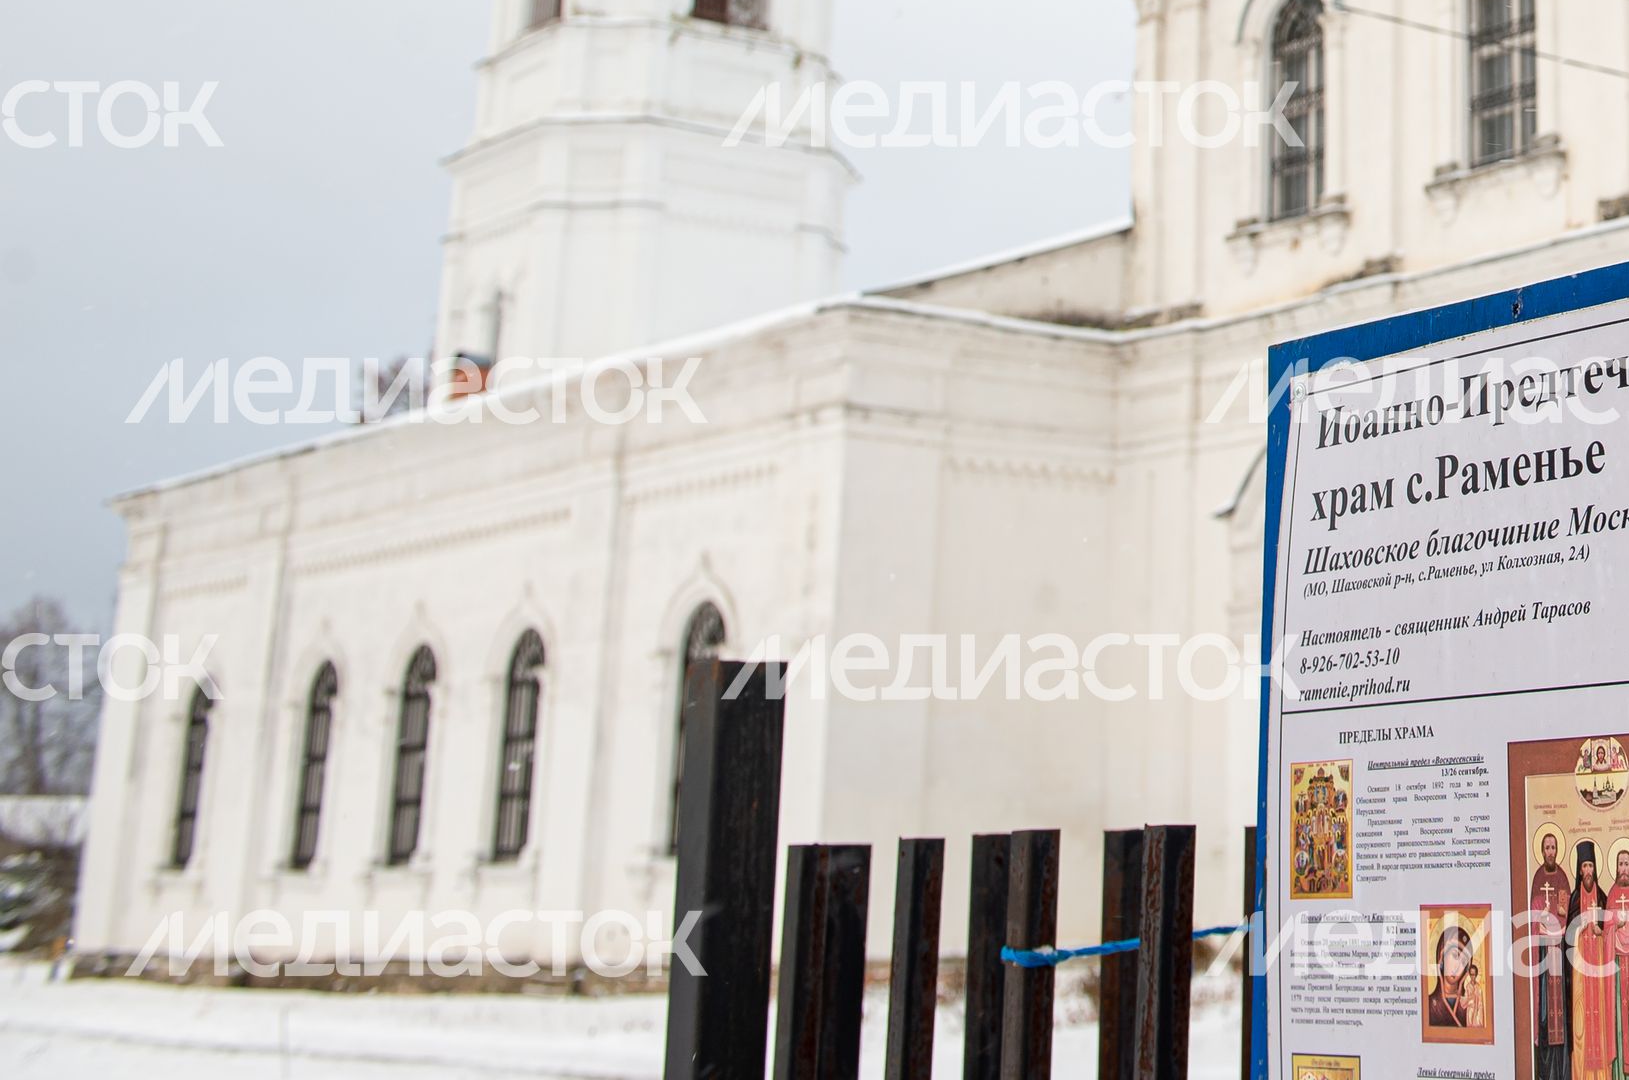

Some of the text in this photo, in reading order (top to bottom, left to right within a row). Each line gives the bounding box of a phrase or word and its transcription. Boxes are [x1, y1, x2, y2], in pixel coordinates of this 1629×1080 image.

[1312, 441, 1605, 530] храм с.Раменье
[1303, 540, 1420, 574] Шаховское
[1426, 519, 1560, 556] благочиние
[1303, 544, 1590, 599] (МО, Шаховской р-н, с.Раменье, ул Колхозная, 2А)
[1300, 626, 1382, 647] Настоятель
[1394, 615, 1470, 636] священник
[1472, 604, 1526, 629] Андрей
[1531, 601, 1591, 623] Тарасов
[1299, 647, 1400, 674] 8-926-702-53-10
[1298, 676, 1410, 701] ramenie.prihod.ru
[1339, 725, 1434, 744] ПРЕДЕЛЫ ХРАМА
